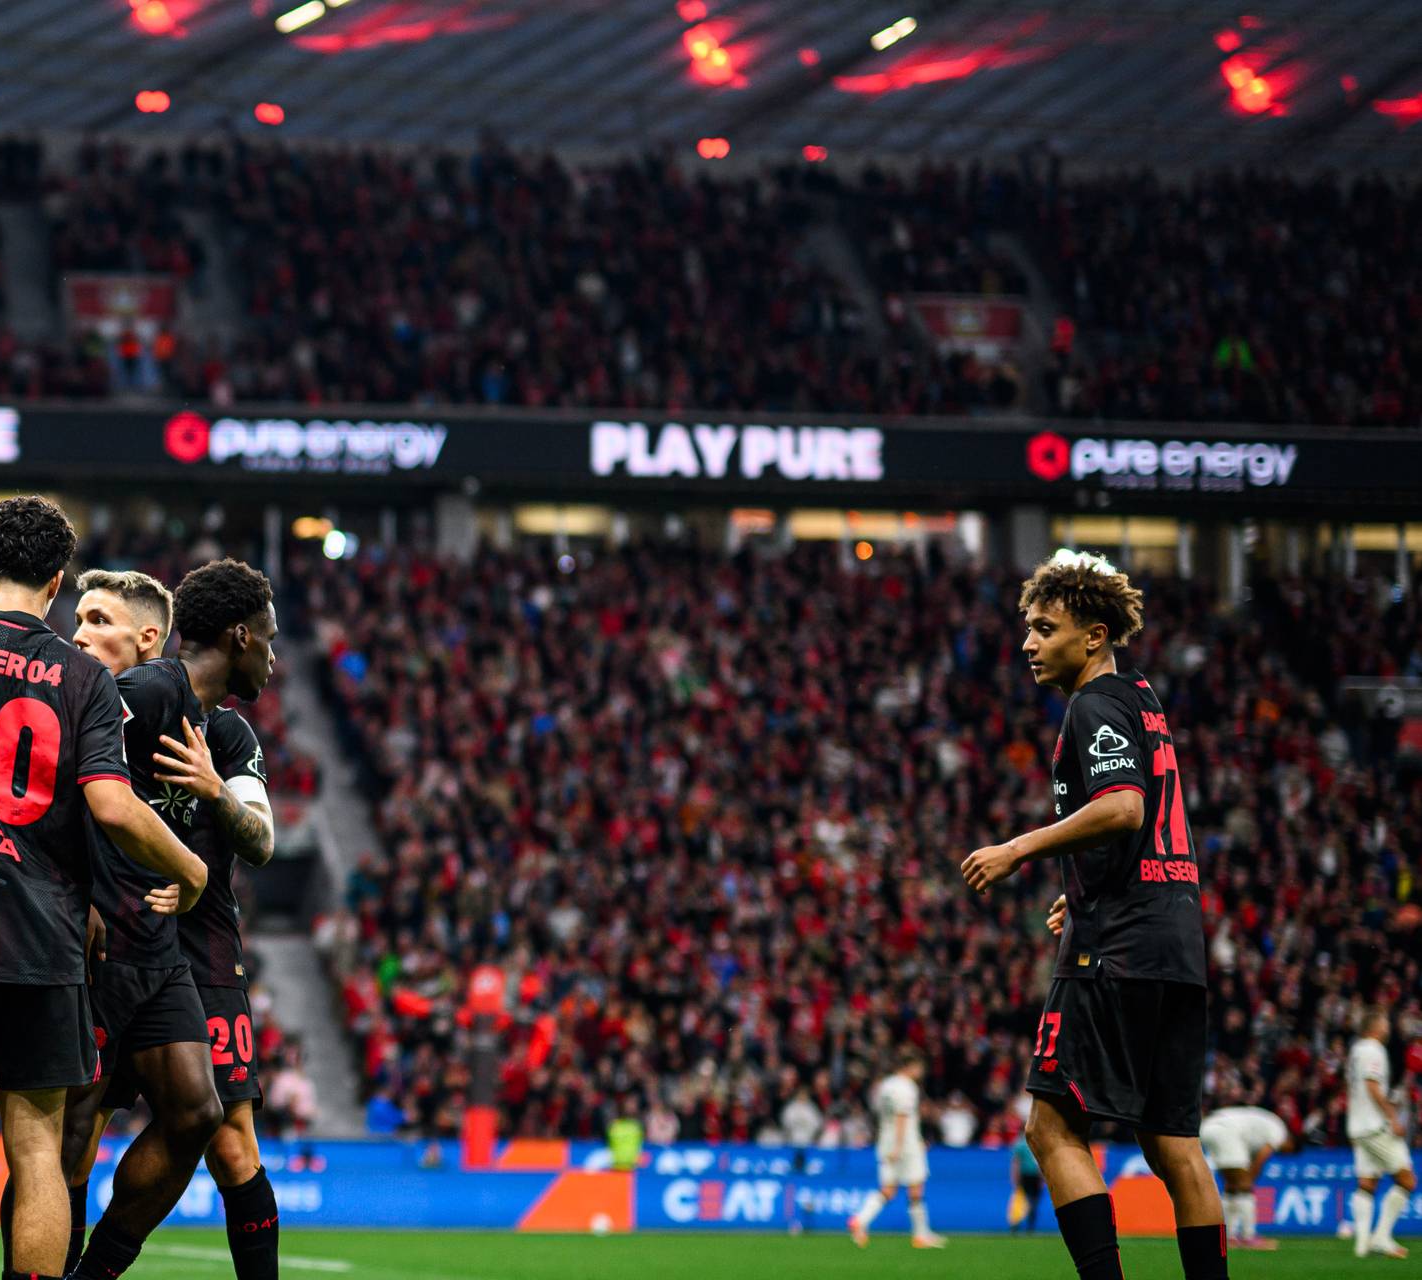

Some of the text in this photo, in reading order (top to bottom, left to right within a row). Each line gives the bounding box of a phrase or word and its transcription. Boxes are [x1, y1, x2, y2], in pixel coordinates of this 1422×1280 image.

[590, 421, 883, 481] PLAY PURE
[27, 660, 63, 687] 04
[1090, 758, 1136, 776] NIEDAX
[206, 1013, 253, 1065] 20
[662, 1178, 781, 1222] CEAT
